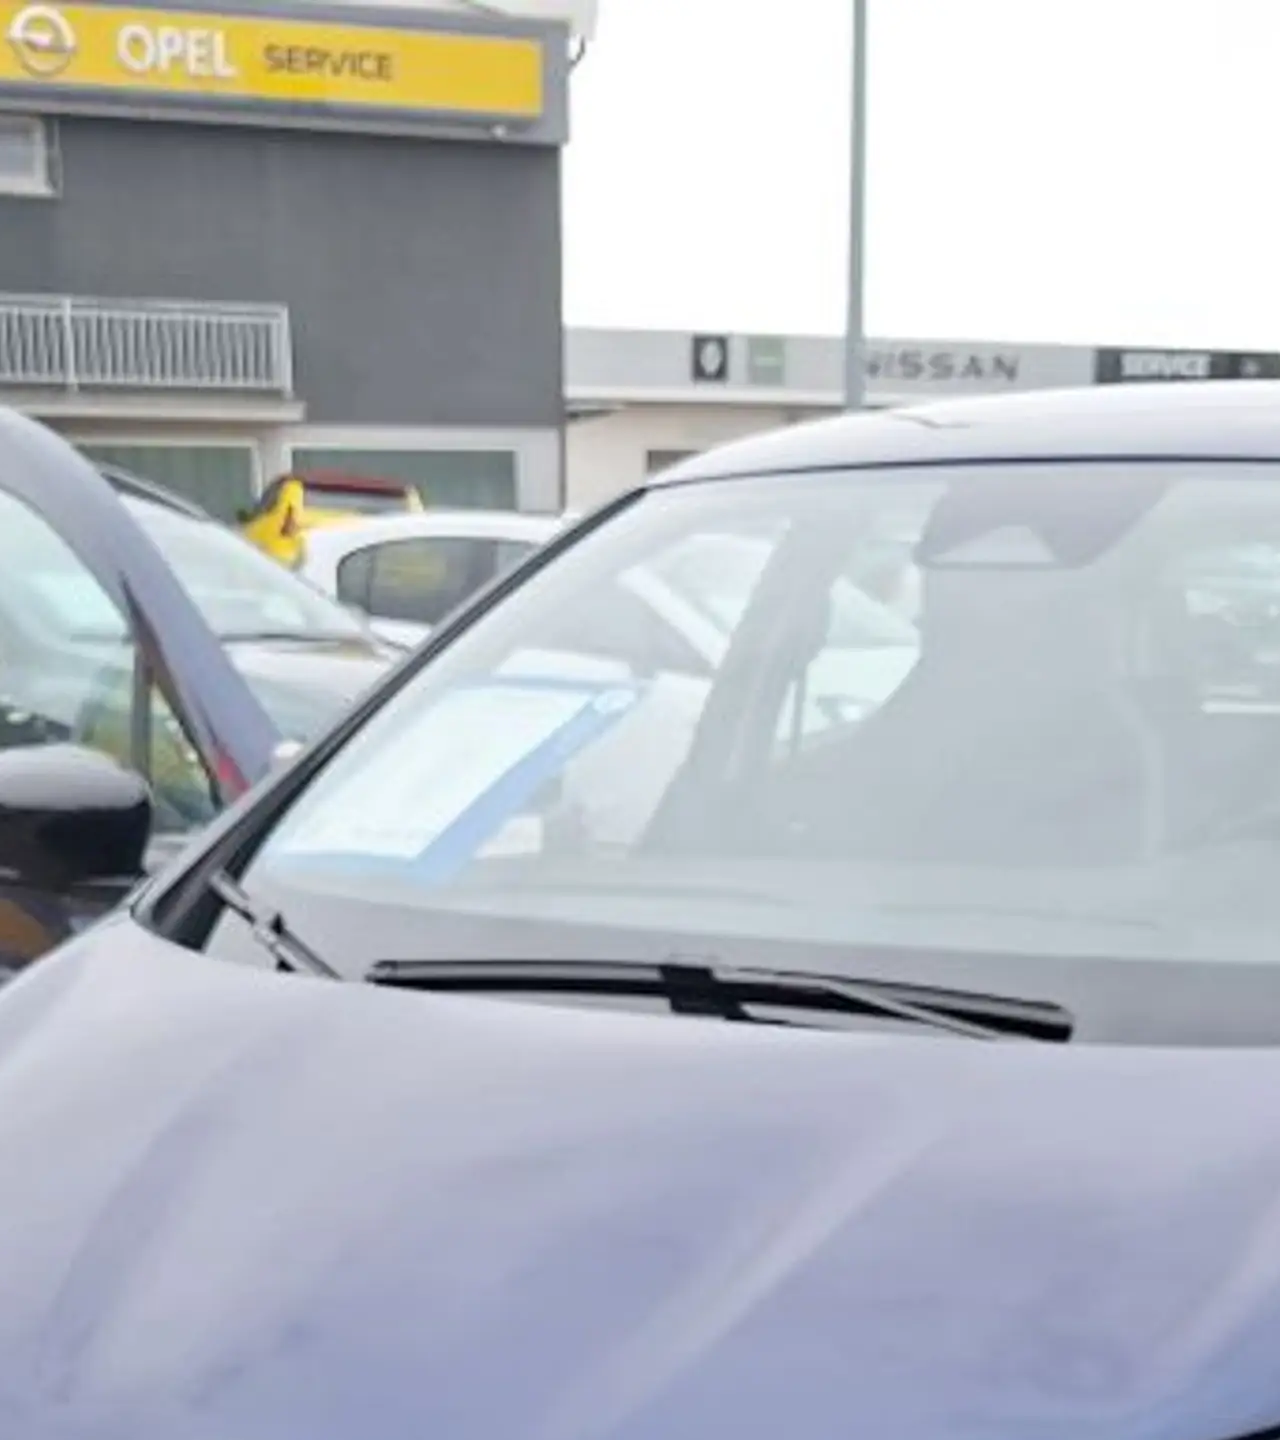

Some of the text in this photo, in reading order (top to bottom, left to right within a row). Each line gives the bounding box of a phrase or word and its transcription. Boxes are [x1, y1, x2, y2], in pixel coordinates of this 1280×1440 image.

[116, 24, 393, 81] OPEL SERVICE
[865, 350, 1018, 381] NISSAN
